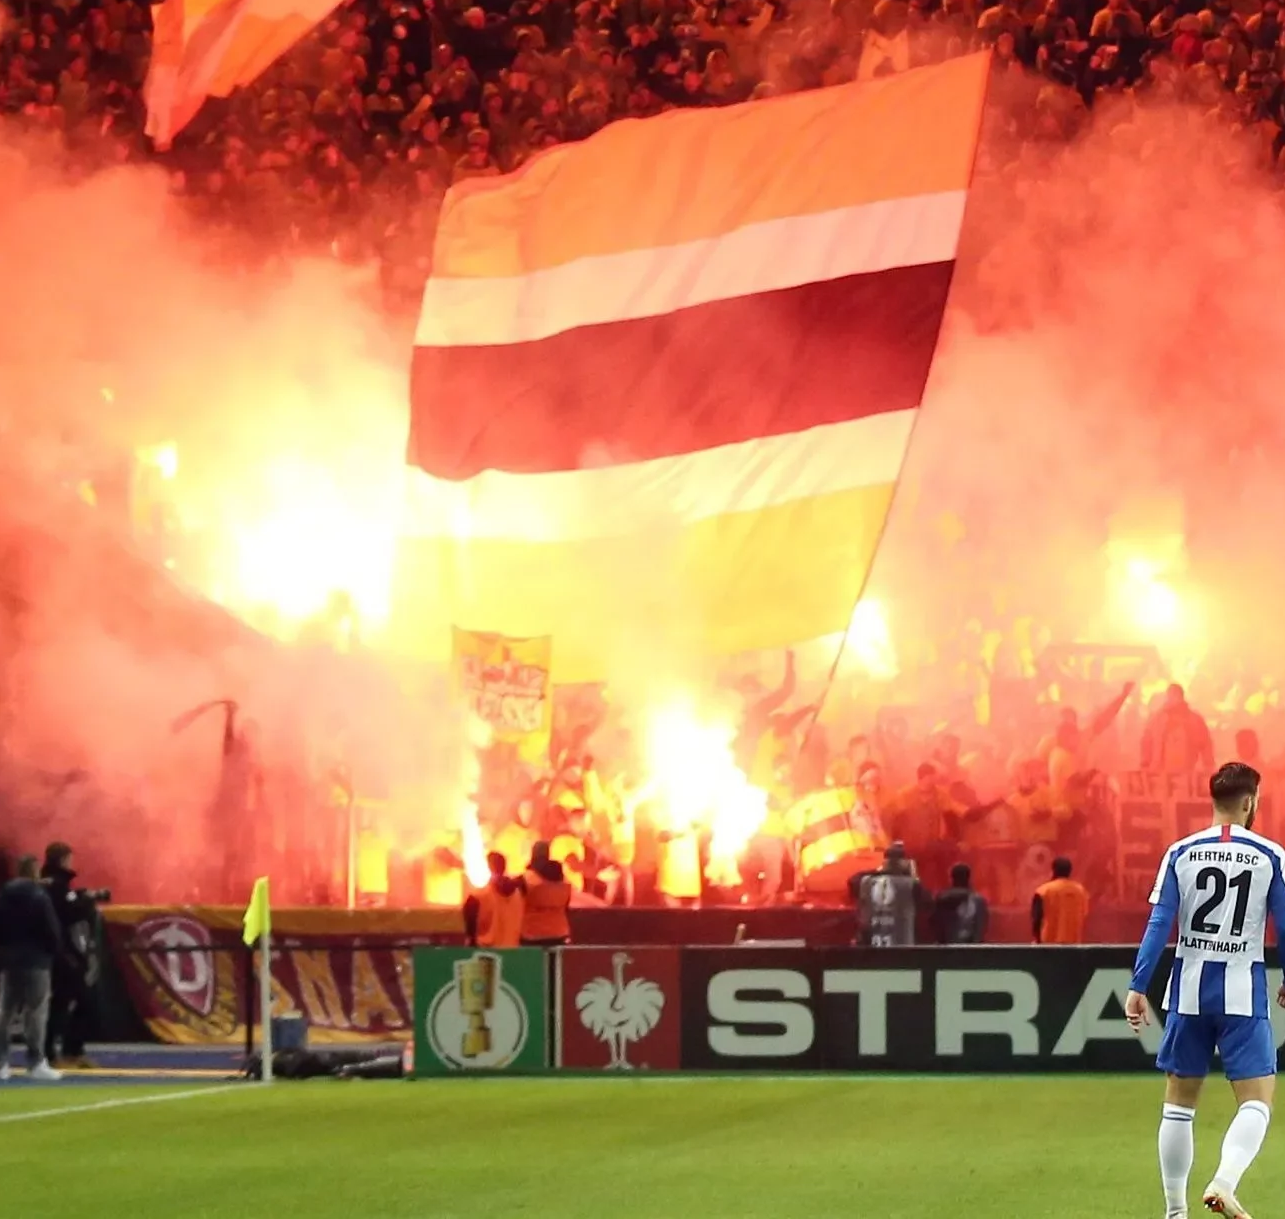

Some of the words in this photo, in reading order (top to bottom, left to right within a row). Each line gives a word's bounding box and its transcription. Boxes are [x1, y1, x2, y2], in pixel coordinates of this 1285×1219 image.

[1189, 851, 1233, 862] HERTHA
[1236, 852, 1259, 866] BSC
[1190, 866, 1253, 937] 21
[1180, 936, 1248, 953] PLATTNHART
